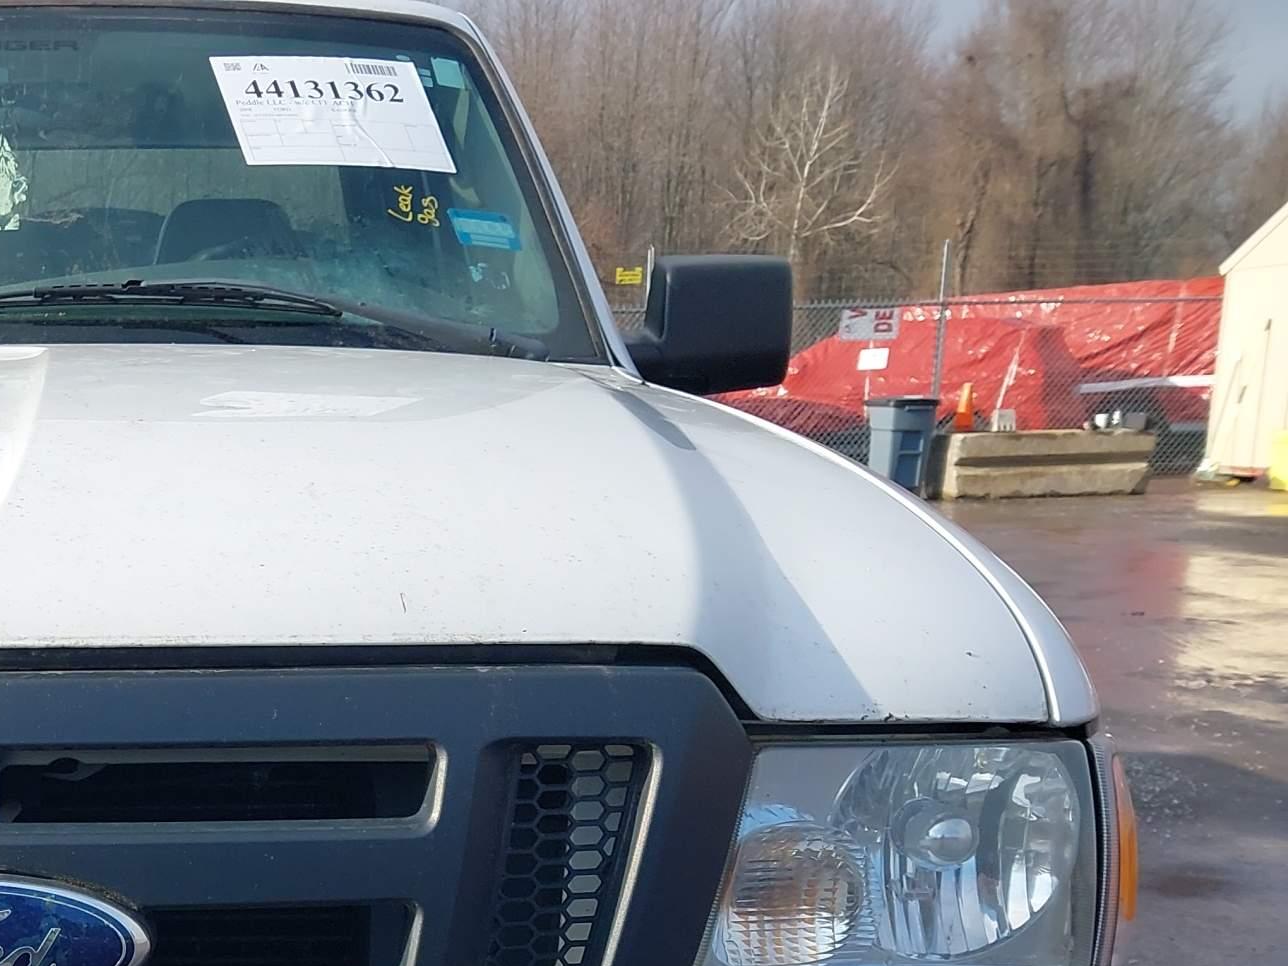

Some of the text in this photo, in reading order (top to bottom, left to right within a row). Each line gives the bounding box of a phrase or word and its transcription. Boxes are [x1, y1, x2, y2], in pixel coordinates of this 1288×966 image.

[244, 79, 404, 103] 44131362
[387, 185, 413, 222] Leak
[416, 195, 440, 227] gas
